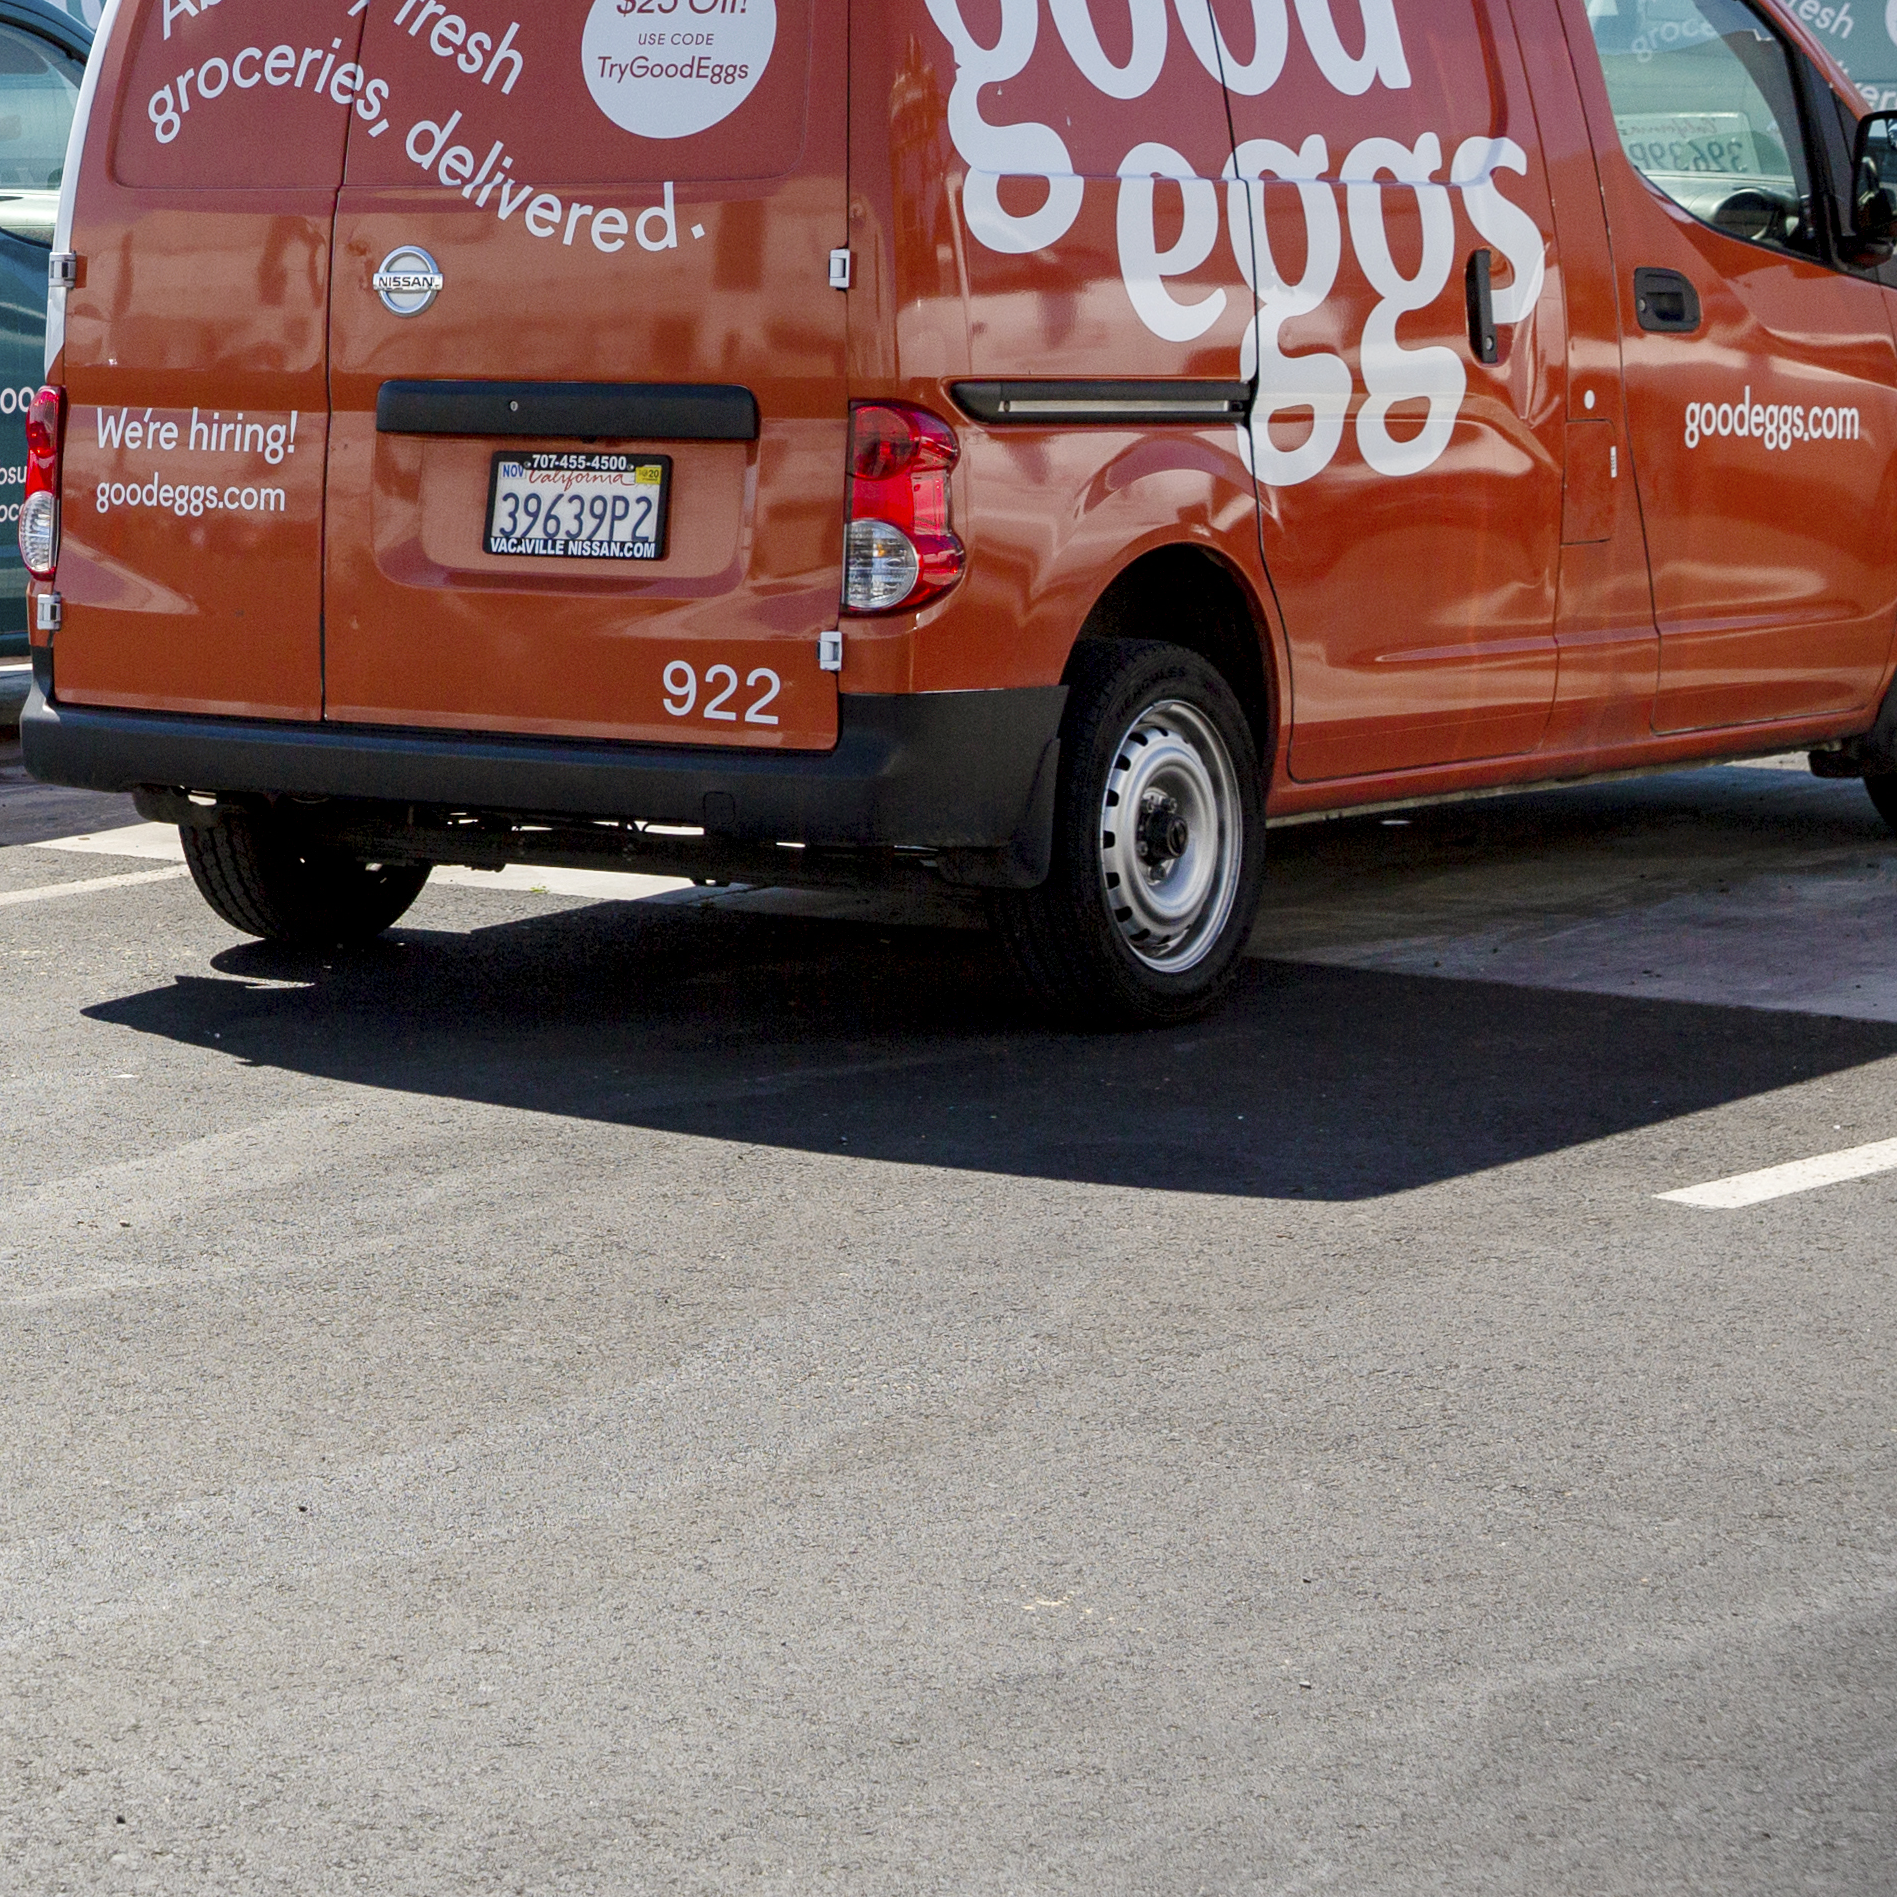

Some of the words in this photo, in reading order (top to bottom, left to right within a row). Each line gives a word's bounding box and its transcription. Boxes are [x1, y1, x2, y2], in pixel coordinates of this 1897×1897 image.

[638, 33, 666, 46] USE
[673, 32, 714, 46] CODE
[598, 55, 749, 84] TryGoodEggs
[148, 38, 391, 144] groceries,
[406, 110, 706, 253] delivered.
[378, 276, 433, 288] NISSAN
[1116, 132, 1545, 487] eggs
[97, 407, 178, 449] We're
[189, 407, 298, 464] hiring!
[1684, 385, 1859, 450] goodeggs.com
[503, 465, 524, 478] NOV
[532, 454, 627, 470] 707-455-4500
[97, 472, 285, 517] goodeggs.com
[499, 492, 652, 541] 39639P2
[490, 537, 564, 554] VACAVILLE
[568, 540, 655, 558] NISSAN.COM
[662, 659, 781, 725] 922
